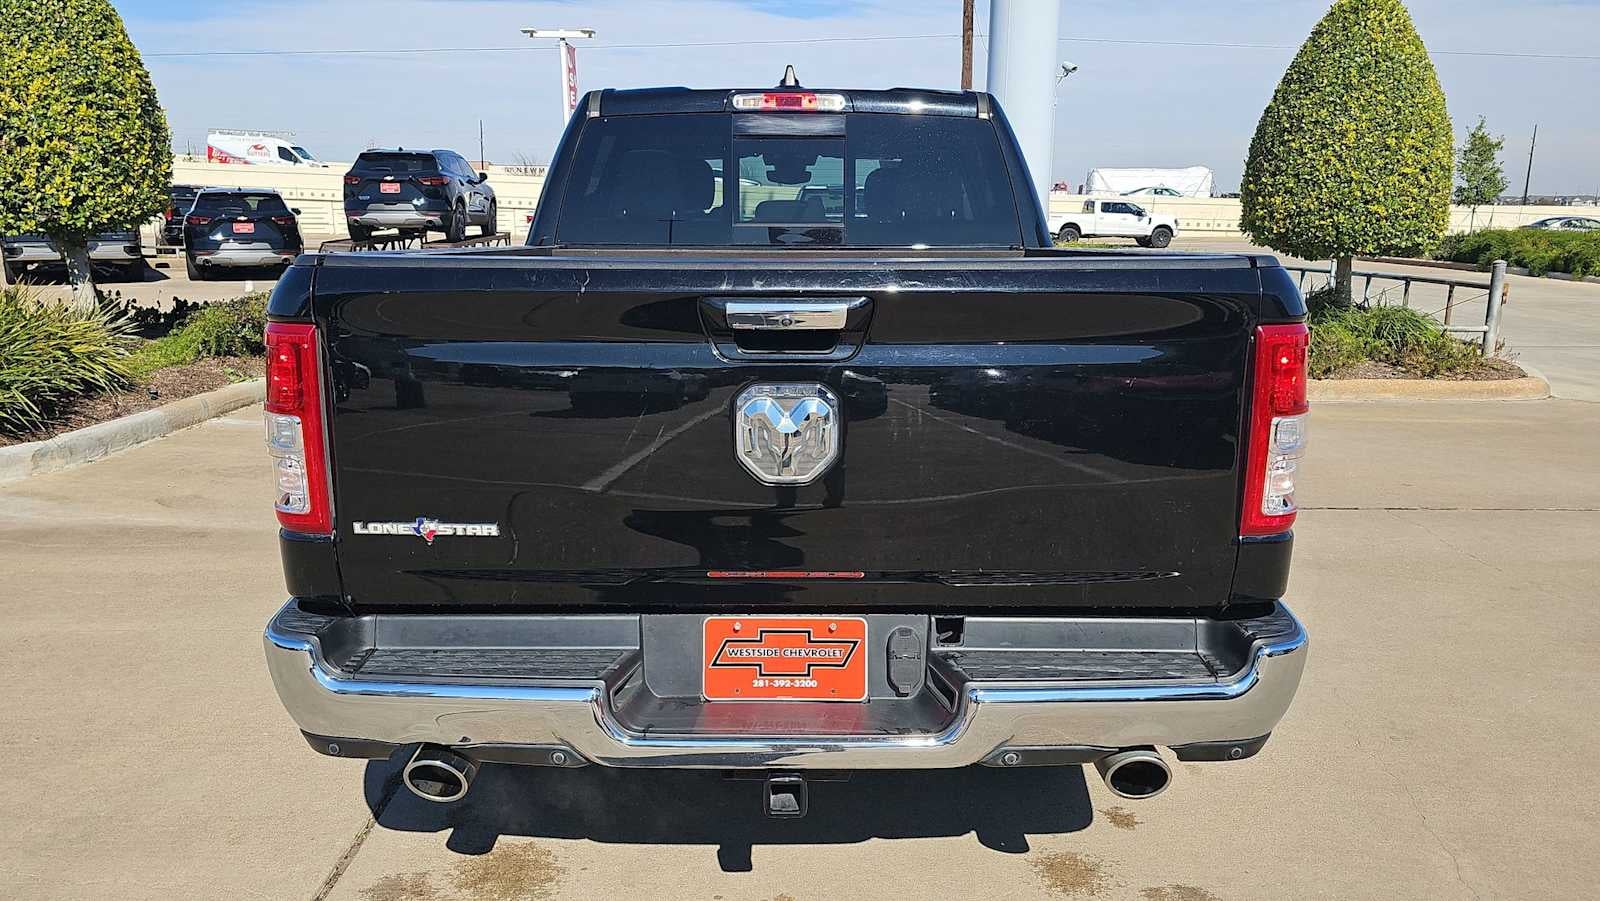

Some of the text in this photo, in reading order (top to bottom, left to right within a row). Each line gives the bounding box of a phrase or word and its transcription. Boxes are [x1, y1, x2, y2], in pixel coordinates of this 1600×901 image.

[352, 520, 500, 537] LONE STAR
[728, 648, 844, 657] WESTSIDE CHEVROLET
[752, 679, 818, 688] 281-392-3200
